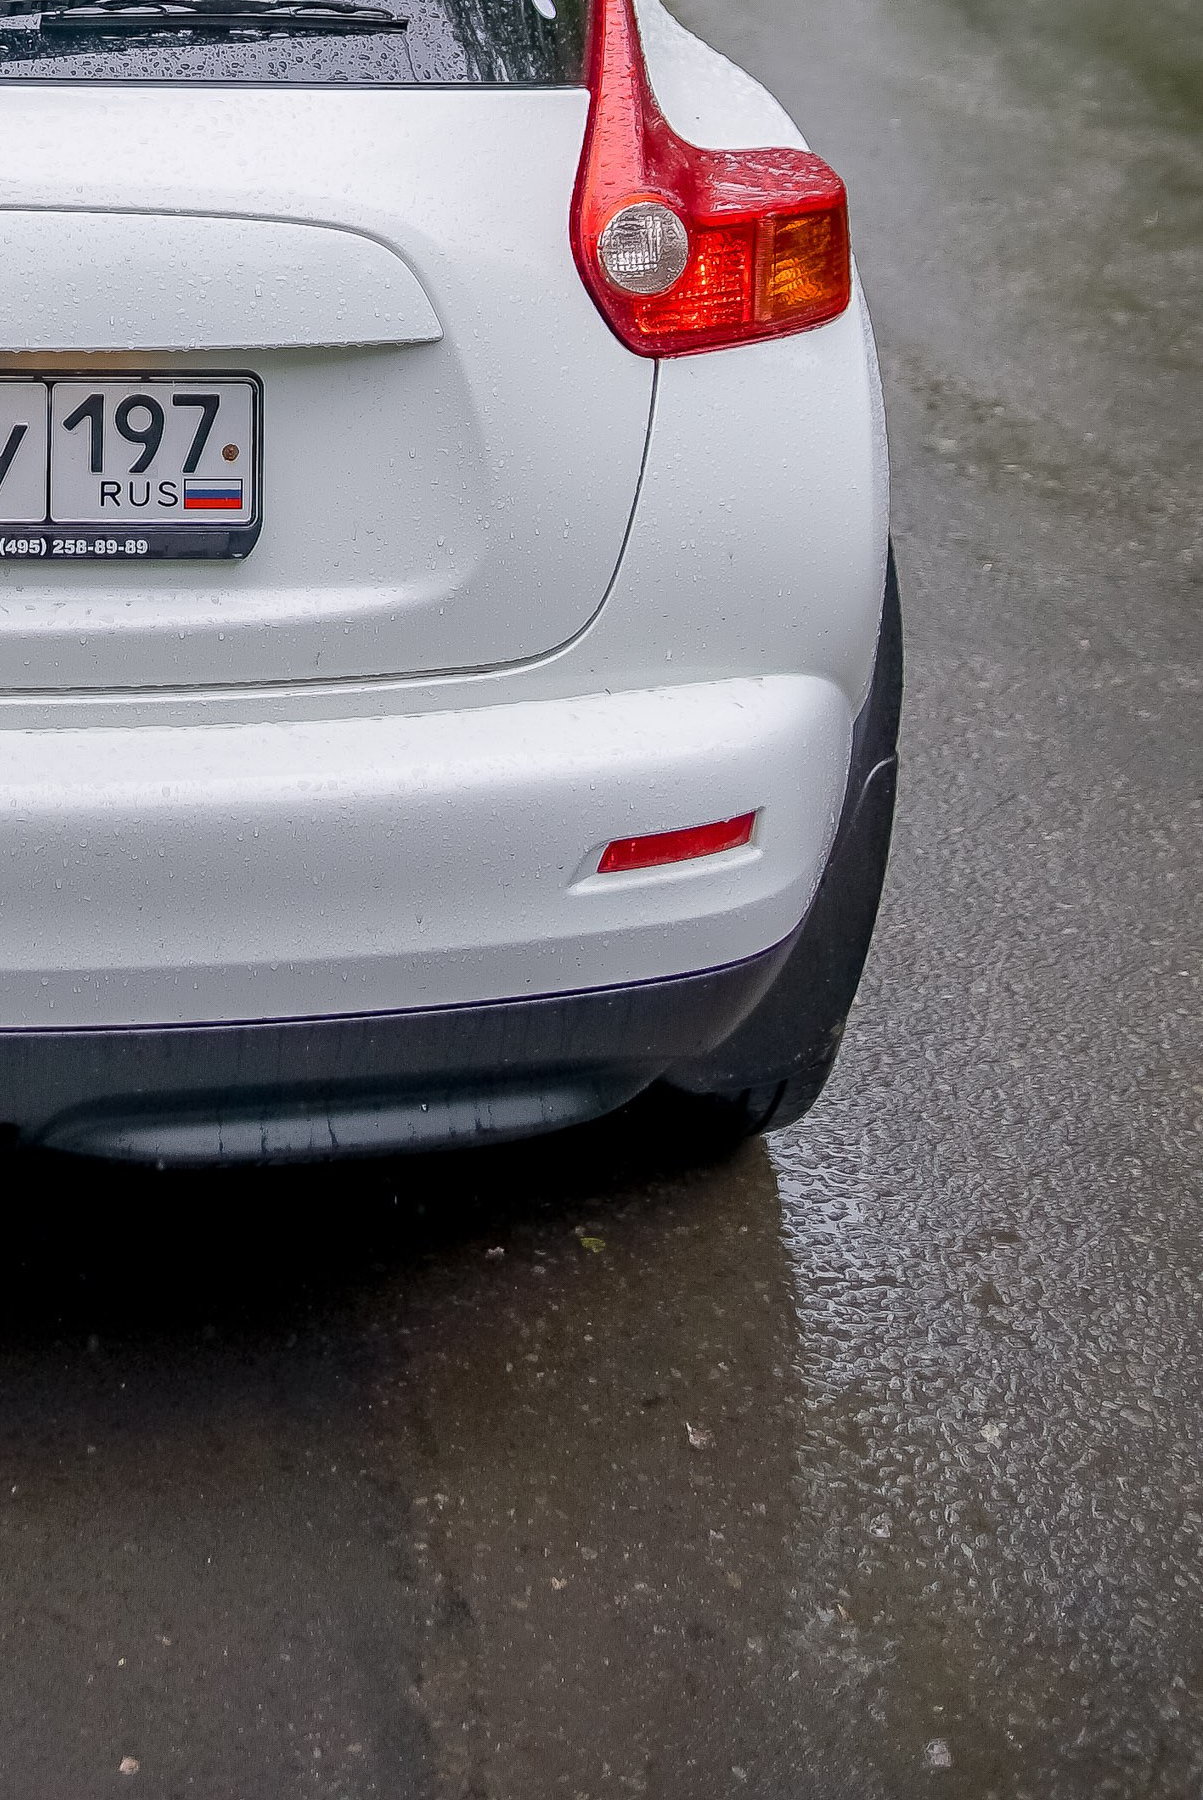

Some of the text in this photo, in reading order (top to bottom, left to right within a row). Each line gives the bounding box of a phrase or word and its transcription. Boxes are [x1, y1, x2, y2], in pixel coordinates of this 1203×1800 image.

[62, 393, 220, 474] 197
[100, 480, 179, 508] RUS
[0, 537, 47, 557] (495)
[52, 539, 148, 555] 258-89-89
